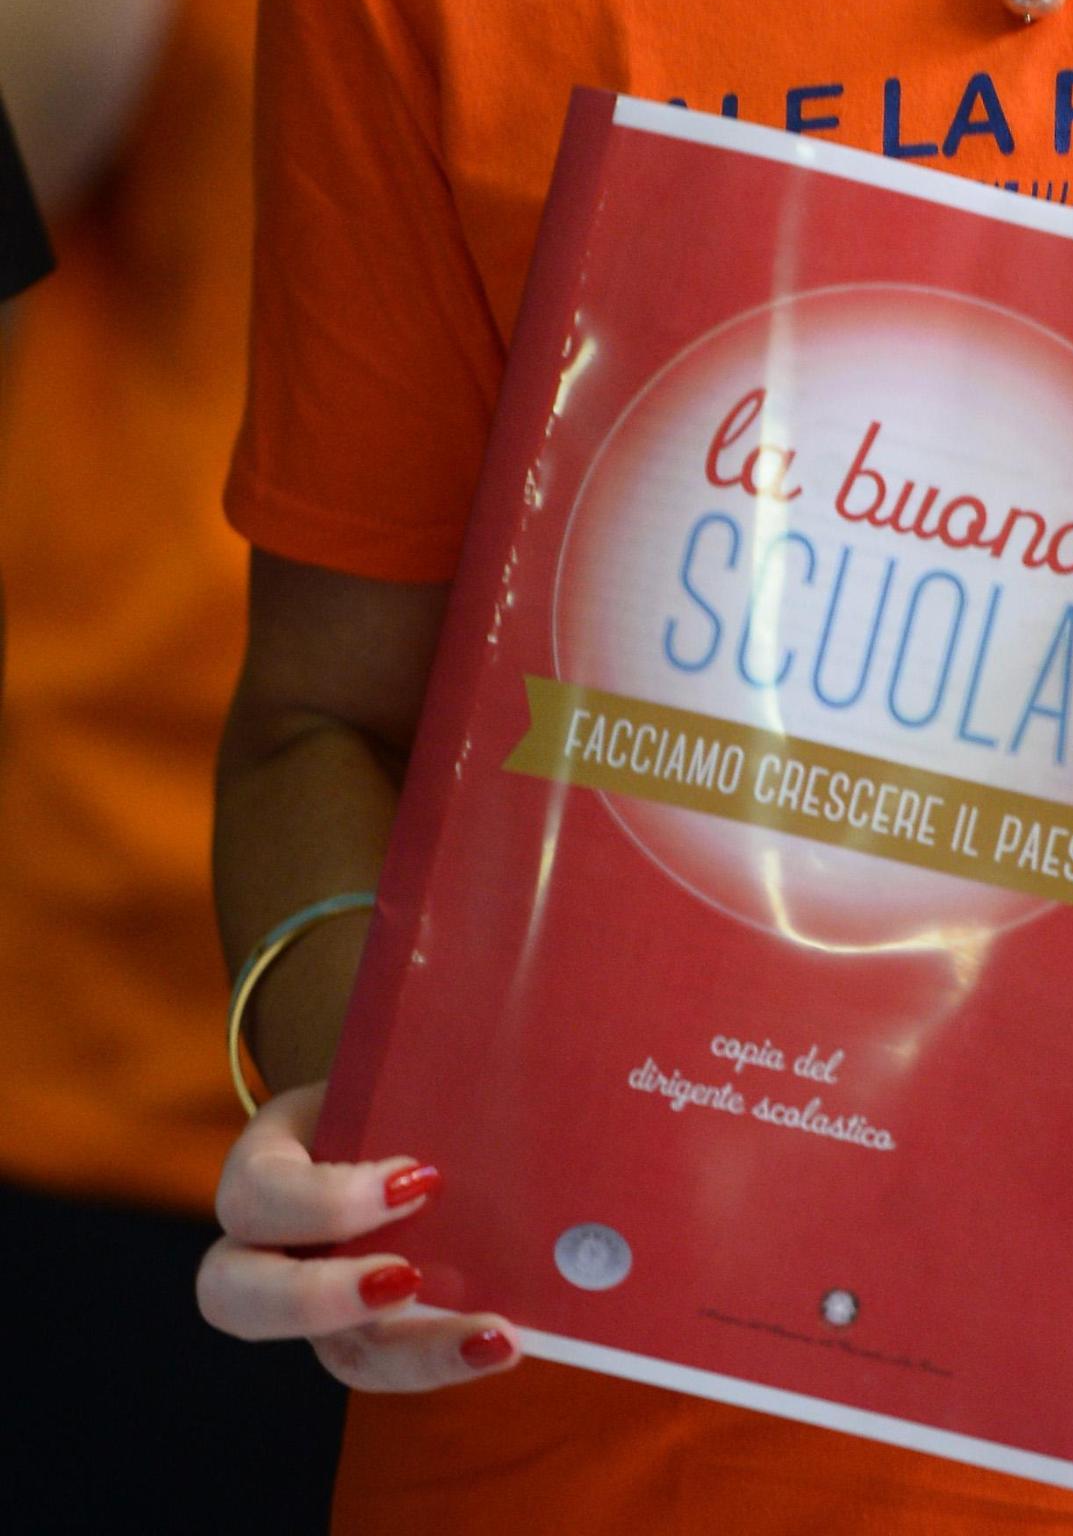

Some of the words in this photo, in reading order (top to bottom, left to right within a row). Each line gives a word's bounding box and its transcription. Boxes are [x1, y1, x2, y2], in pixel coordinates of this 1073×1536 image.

[882, 71, 1017, 159] LA
[704, 387, 803, 504] la
[564, 709, 744, 795] FACCIAMO
[753, 754, 945, 847] CRESCERE
[951, 803, 980, 860] IL
[627, 1055, 746, 1113] dirigente
[751, 1095, 897, 1152] scolastico
[709, 1033, 786, 1074] copia
[792, 1043, 846, 1085] del
